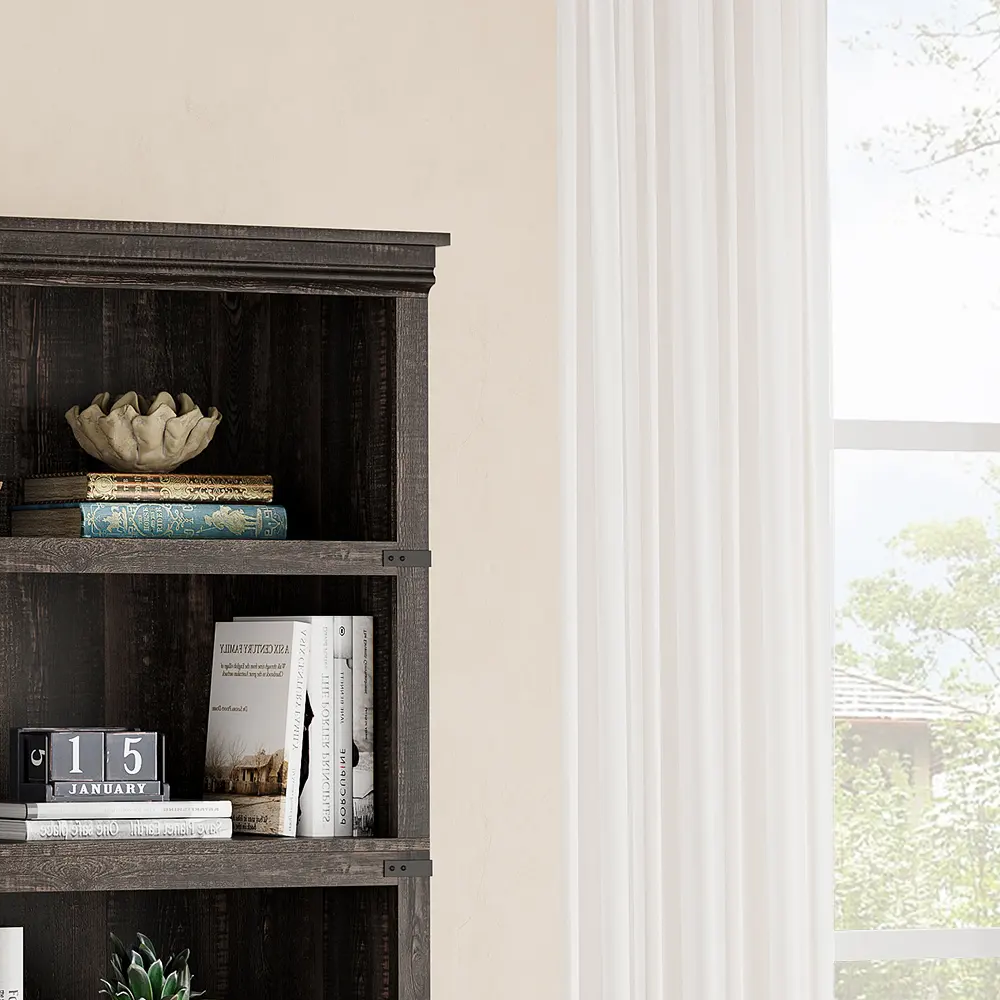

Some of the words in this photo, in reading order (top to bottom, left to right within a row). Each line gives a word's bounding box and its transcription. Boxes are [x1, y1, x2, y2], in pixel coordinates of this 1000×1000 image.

[68, 735, 83, 774] 1
[123, 737, 142, 775] 5
[68, 784, 146, 795] JANUARY
